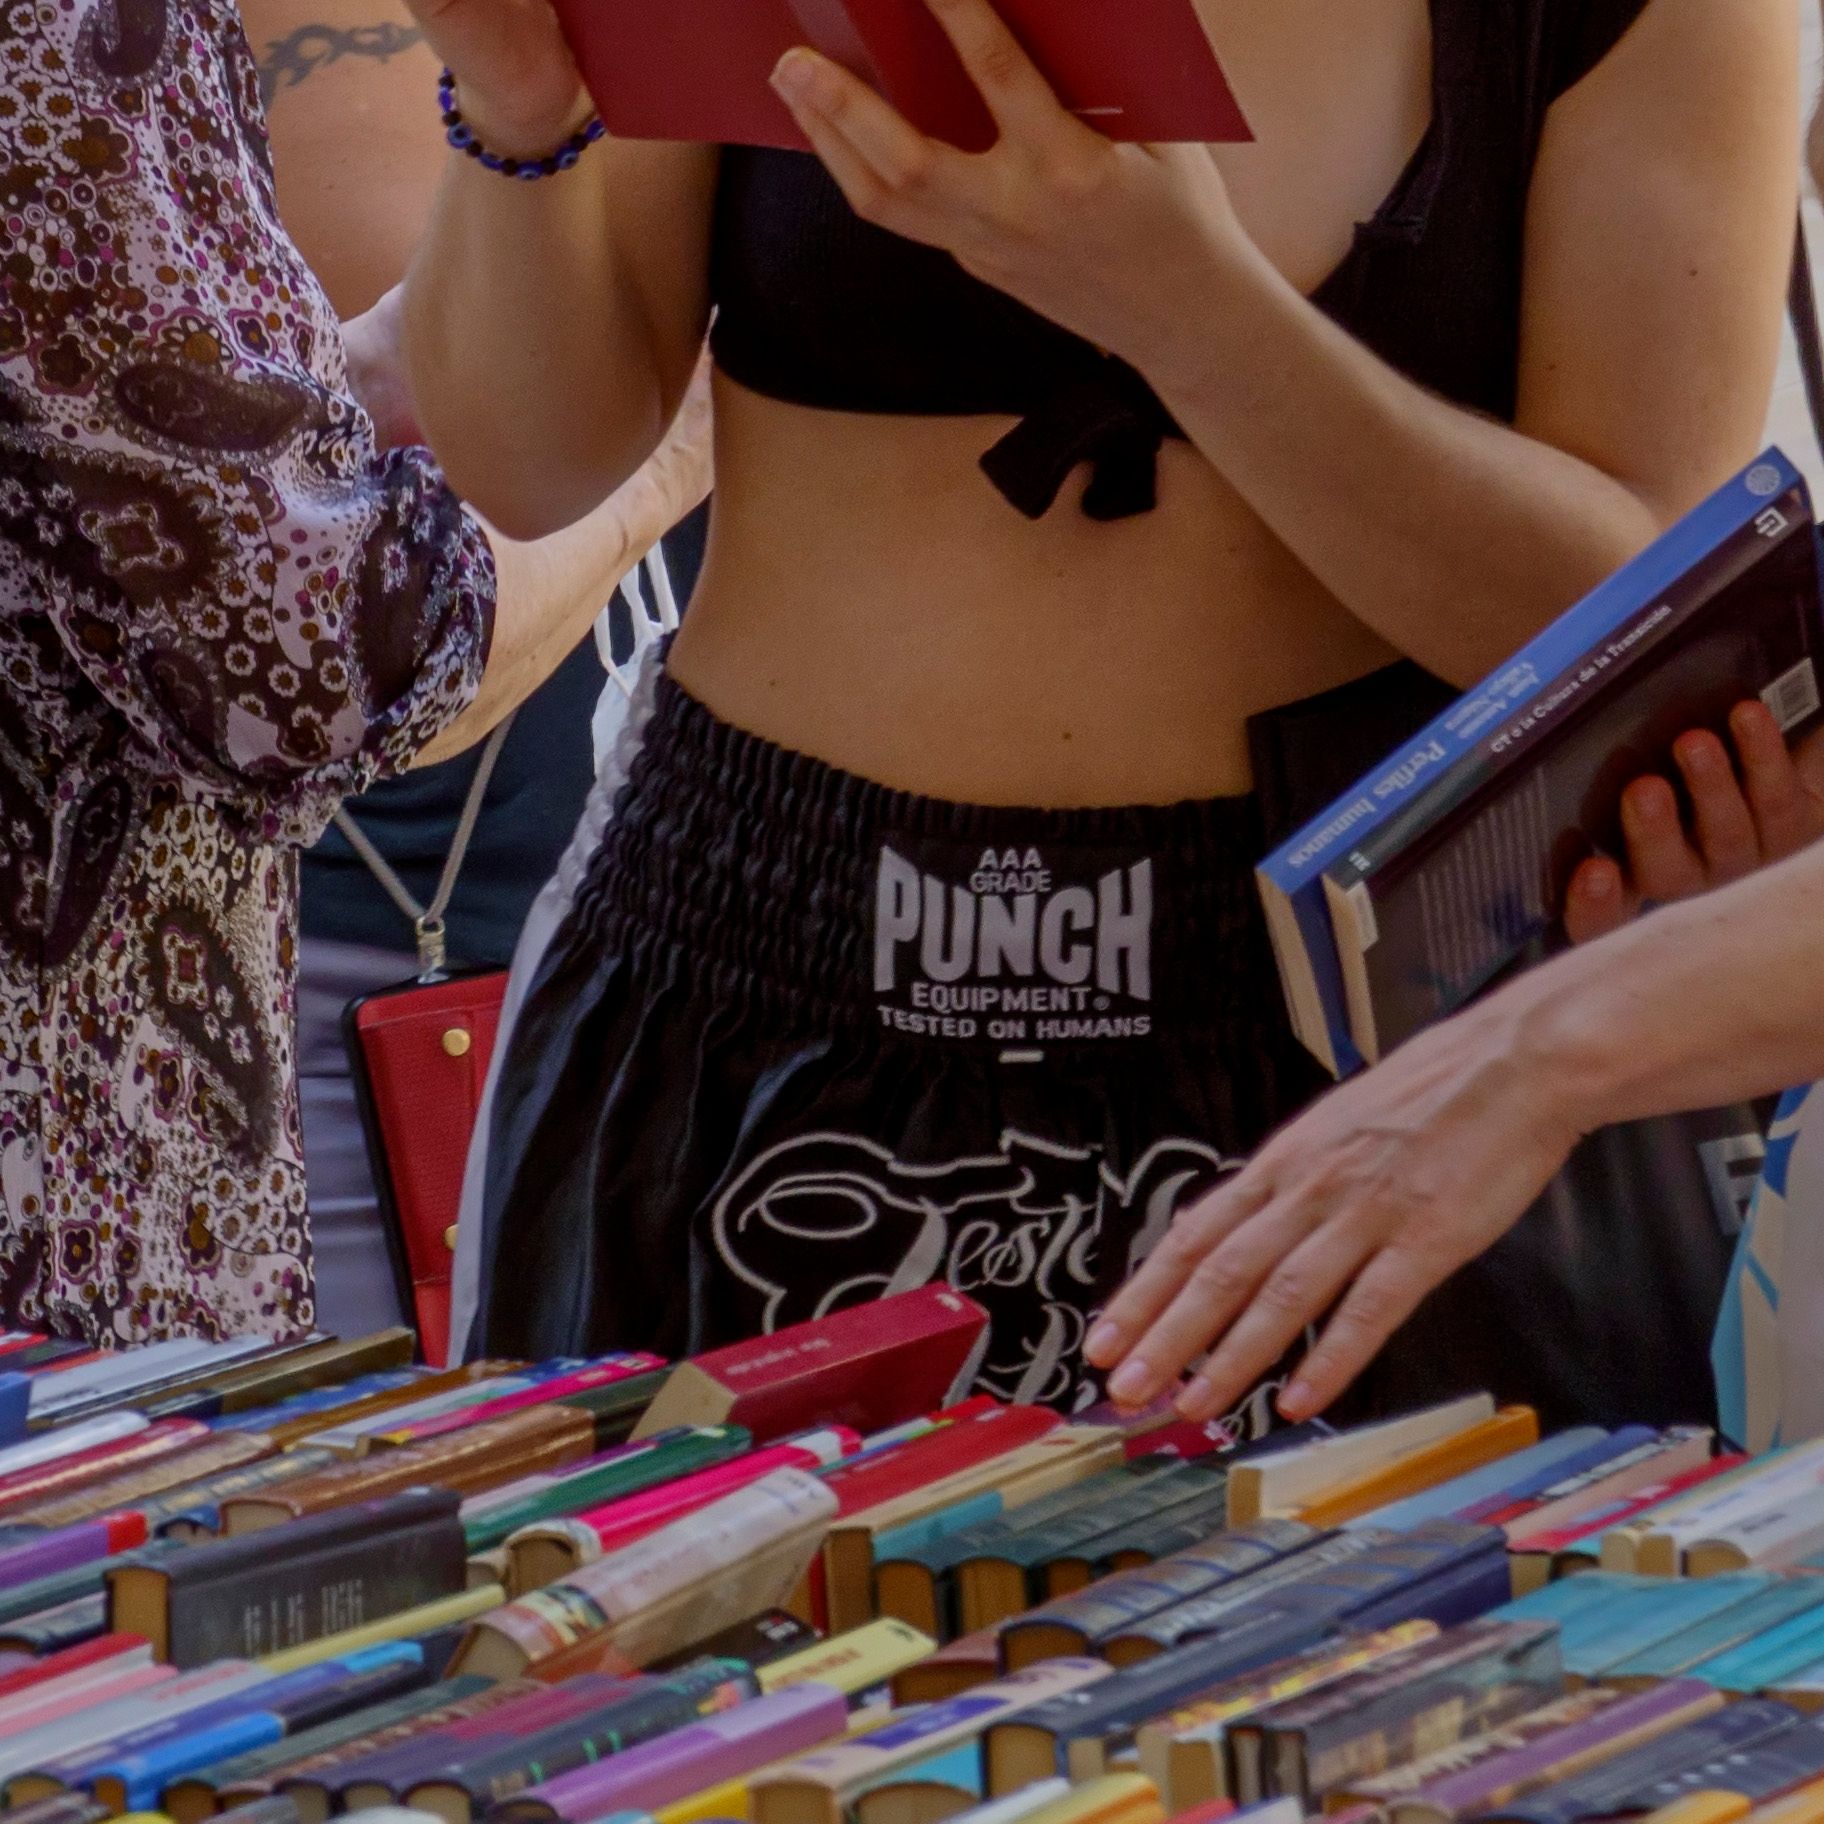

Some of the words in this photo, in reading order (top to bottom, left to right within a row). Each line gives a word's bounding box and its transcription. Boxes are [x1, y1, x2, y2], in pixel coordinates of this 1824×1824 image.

[1372, 739, 1447, 798] Perfiles
[1287, 796, 1377, 869] humanos
[978, 847, 1042, 870] AAA
[969, 869, 1052, 894] GRADE
[874, 844, 1153, 1002] PUNCH
[909, 980, 1092, 1015] EQUIPMENT
[877, 1003, 977, 1039] TESTED
[986, 1019, 1026, 1040] ON
[1034, 1014, 1152, 1040] HUMANS
